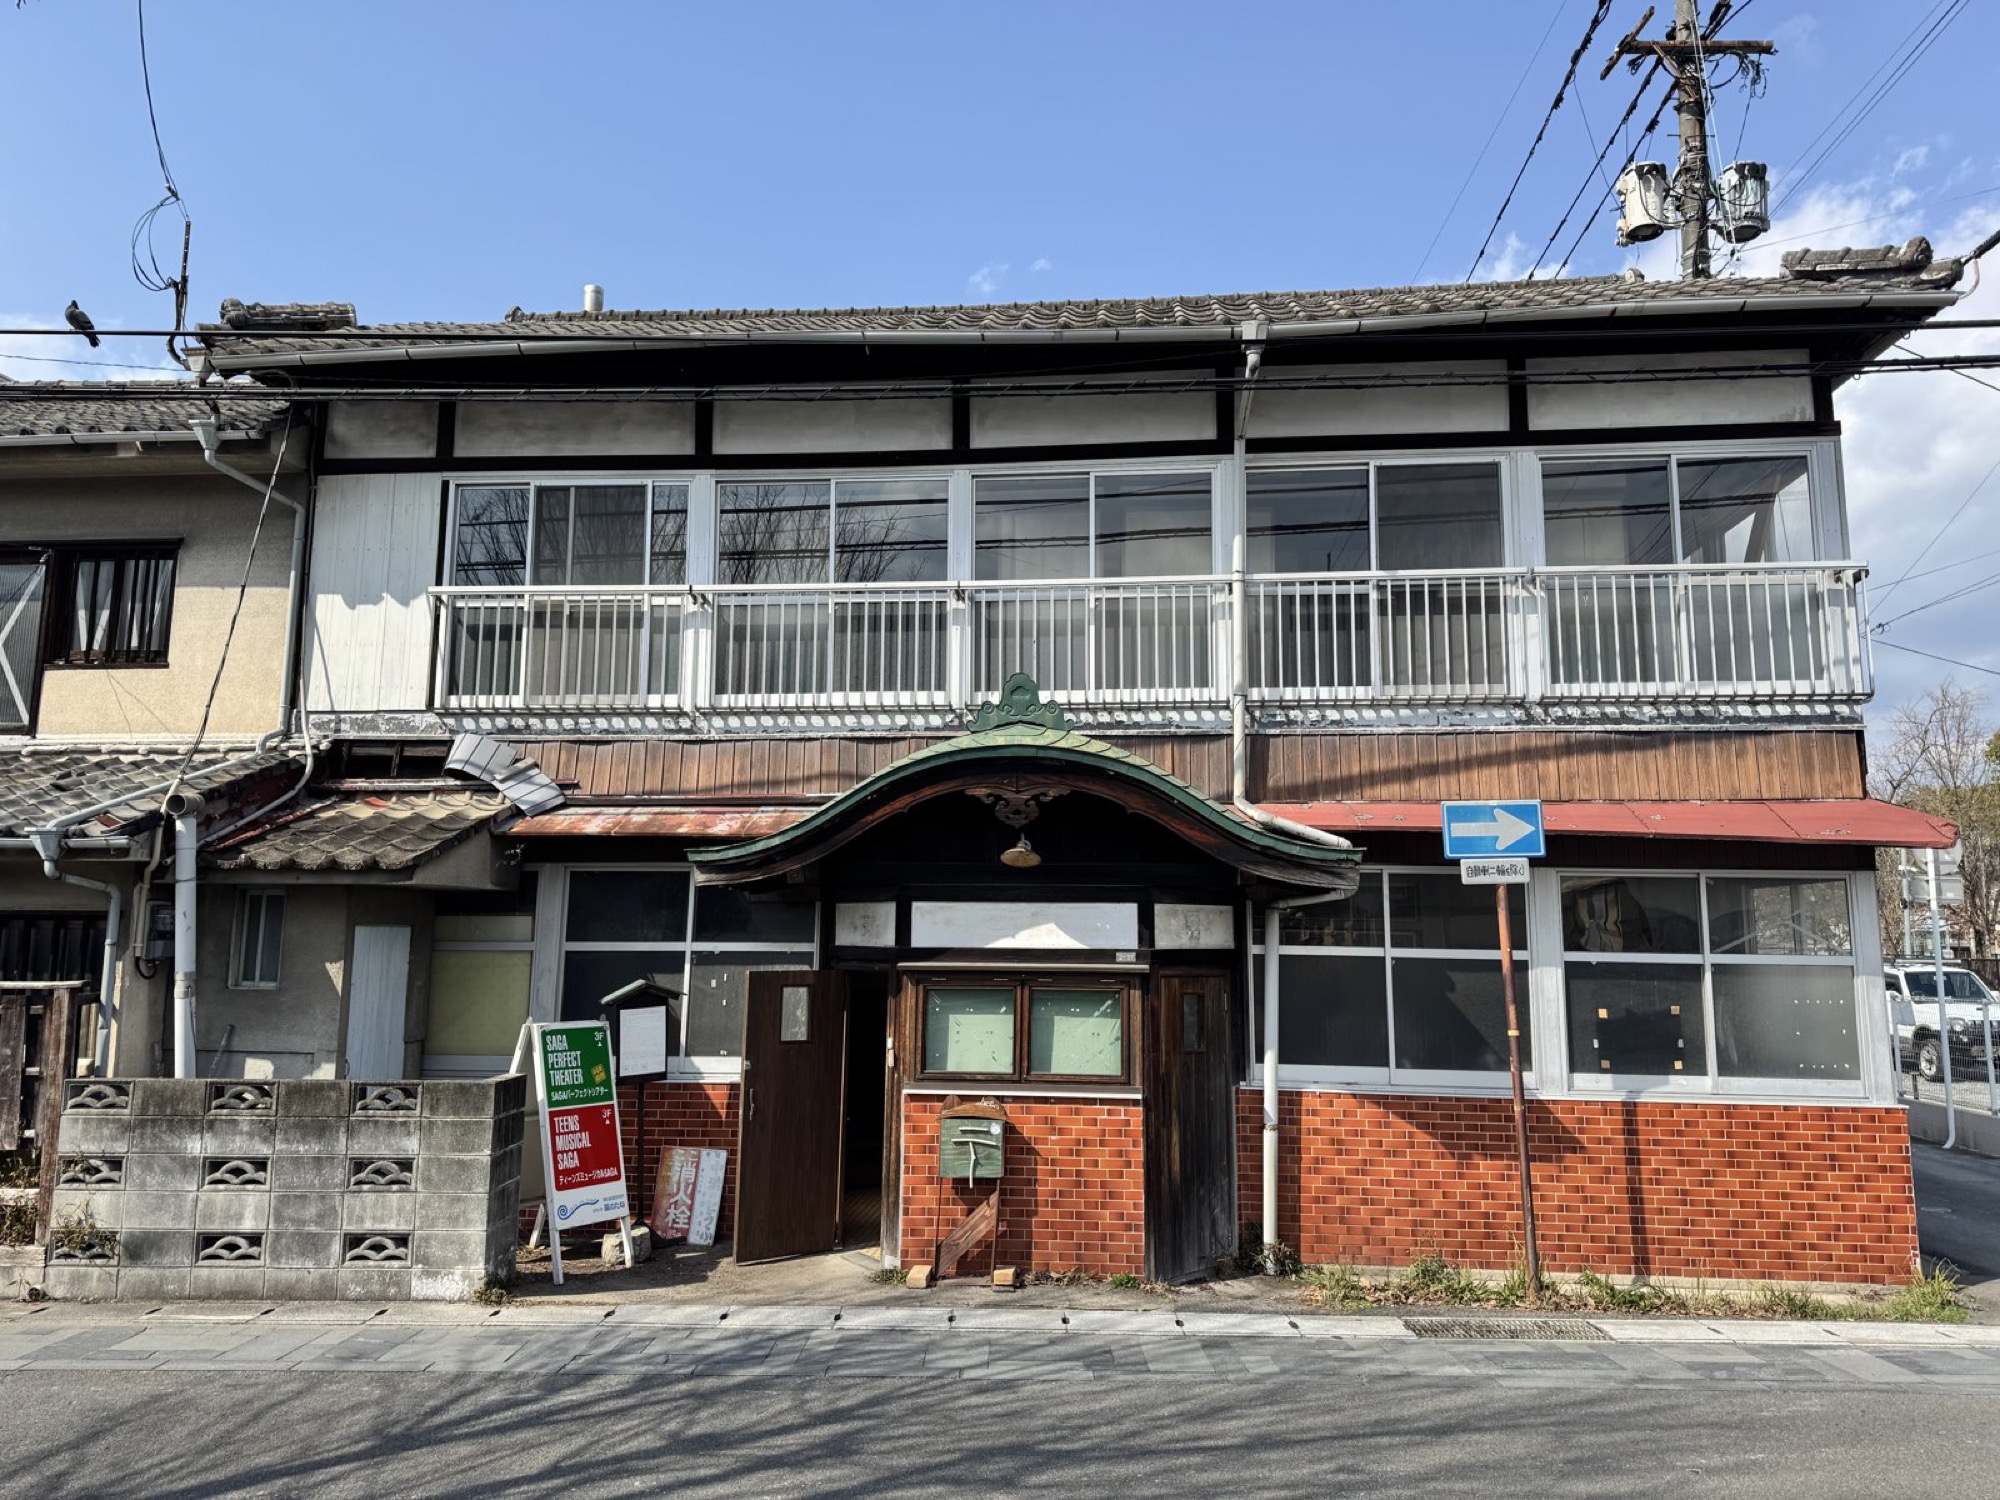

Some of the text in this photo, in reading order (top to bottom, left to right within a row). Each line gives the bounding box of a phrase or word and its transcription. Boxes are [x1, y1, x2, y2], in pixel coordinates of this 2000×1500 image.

[546, 1034, 568, 1051] SAGA
[594, 1031, 604, 1041] 3F
[548, 1050, 581, 1069] PERFECT
[549, 1068, 584, 1087] THEATER
[551, 1086, 609, 1101] SAGAパーフェクトシアター
[602, 1108, 611, 1118] 3F
[554, 1115, 579, 1134] TEENS
[555, 1131, 592, 1151] MUSICAL
[557, 1150, 580, 1170] SAGA
